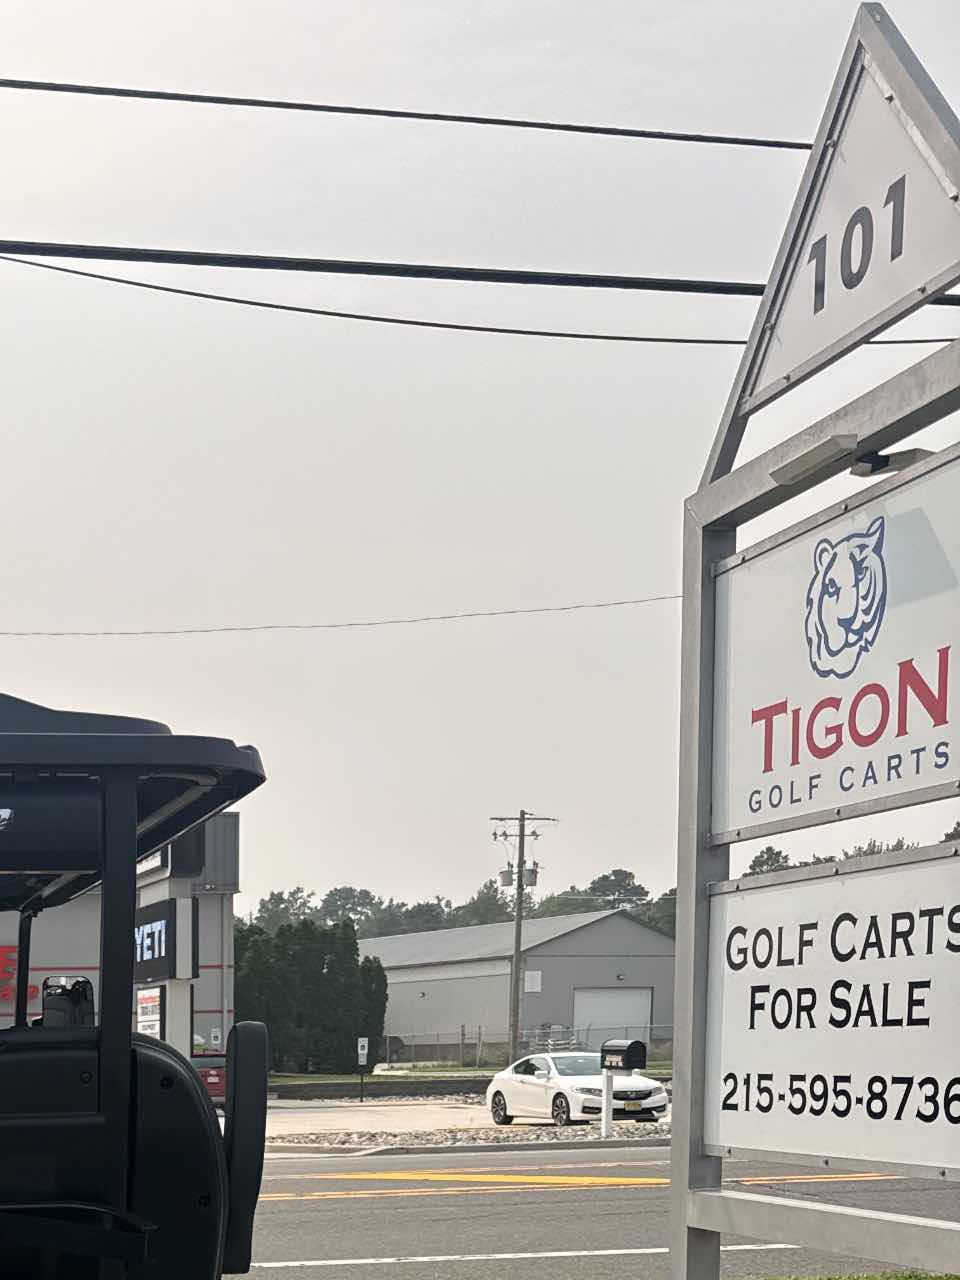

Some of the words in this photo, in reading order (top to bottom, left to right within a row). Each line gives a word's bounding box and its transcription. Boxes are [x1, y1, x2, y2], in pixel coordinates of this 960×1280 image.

[807, 174, 906, 316] 101
[751, 646, 951, 774] TIGON
[749, 774, 821, 813] GOLF
[840, 741, 949, 792] CARTS
[135, 920, 166, 962] YETI
[726, 920, 818, 971] GOLF
[830, 904, 960, 962] CARTS
[749, 975, 817, 1030] FOR
[829, 979, 931, 1028] SALE
[722, 1072, 960, 1124] 215-595-8736
